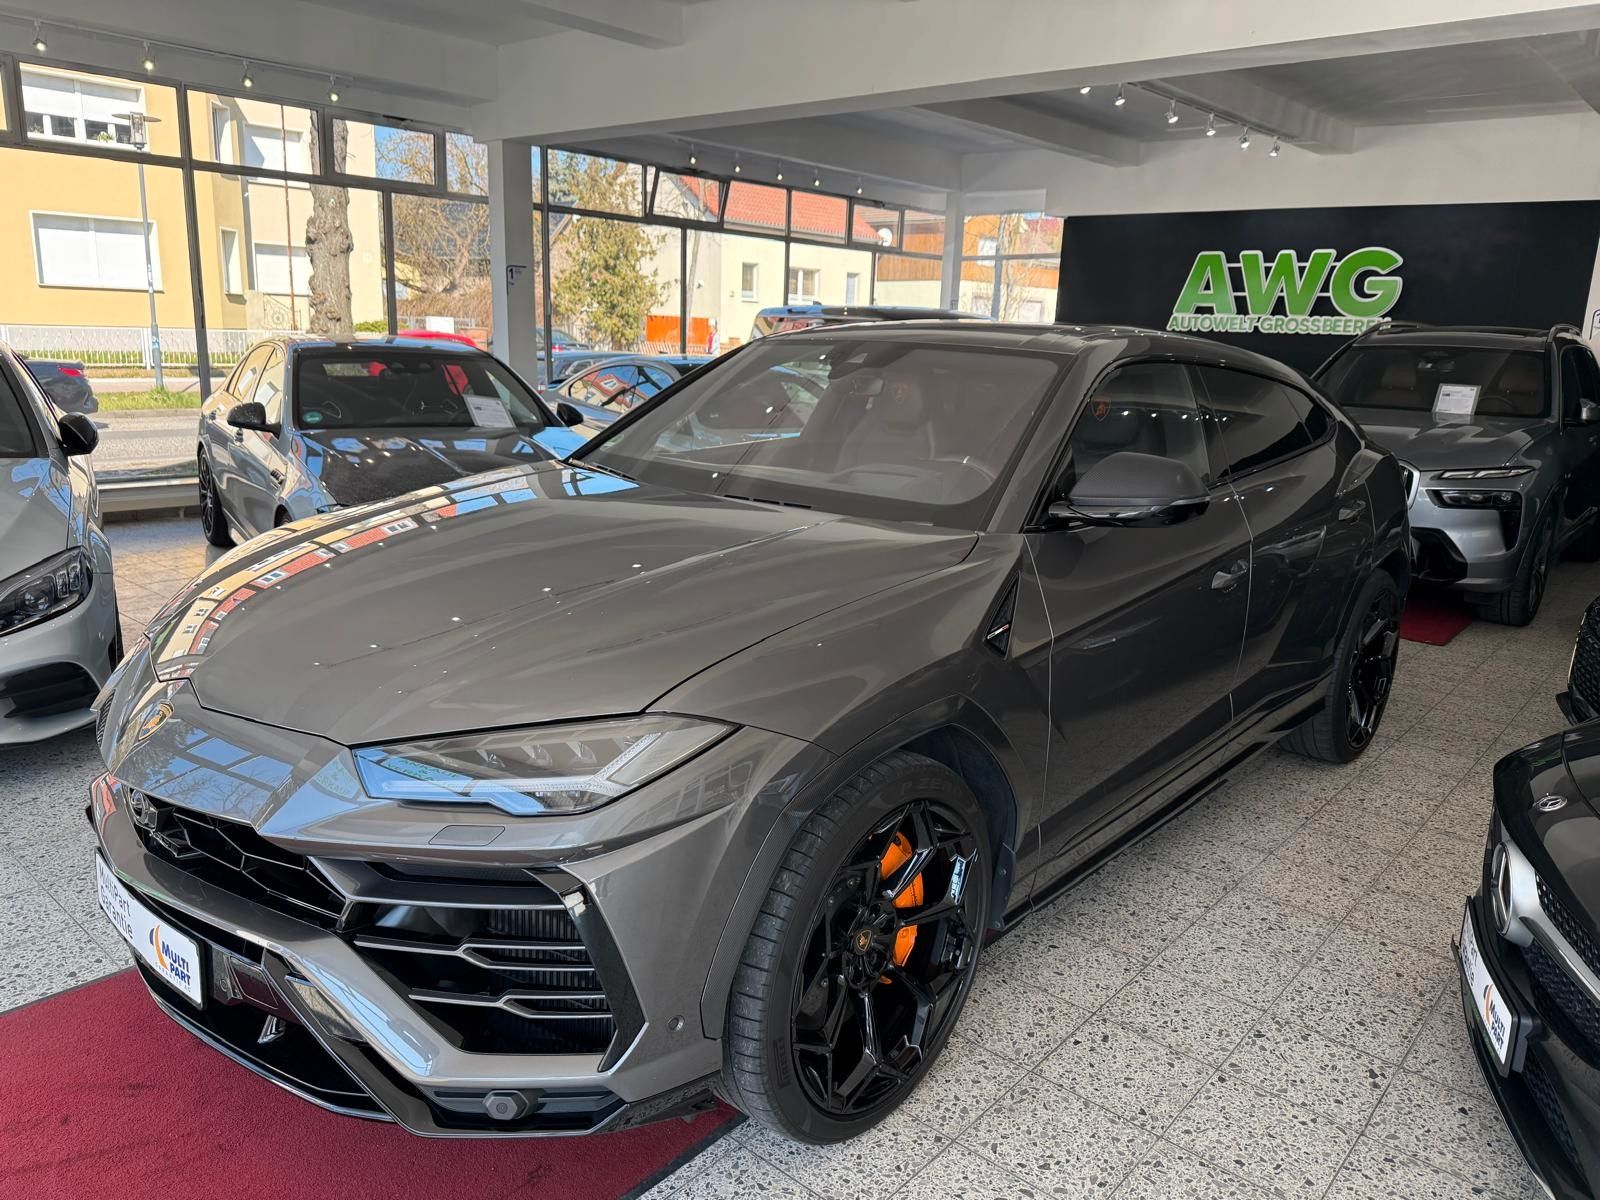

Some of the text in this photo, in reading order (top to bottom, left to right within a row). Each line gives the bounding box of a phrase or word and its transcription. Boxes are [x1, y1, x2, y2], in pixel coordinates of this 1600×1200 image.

[1173, 247, 1403, 317] AWG
[1168, 314, 1257, 331] AUTOWELT
[100, 885, 134, 940] Garantie
[161, 940, 190, 973] MULTI
[169, 961, 191, 986] PART
[1489, 999, 1506, 1038] MULTI
[1491, 1020, 1504, 1050] PART
